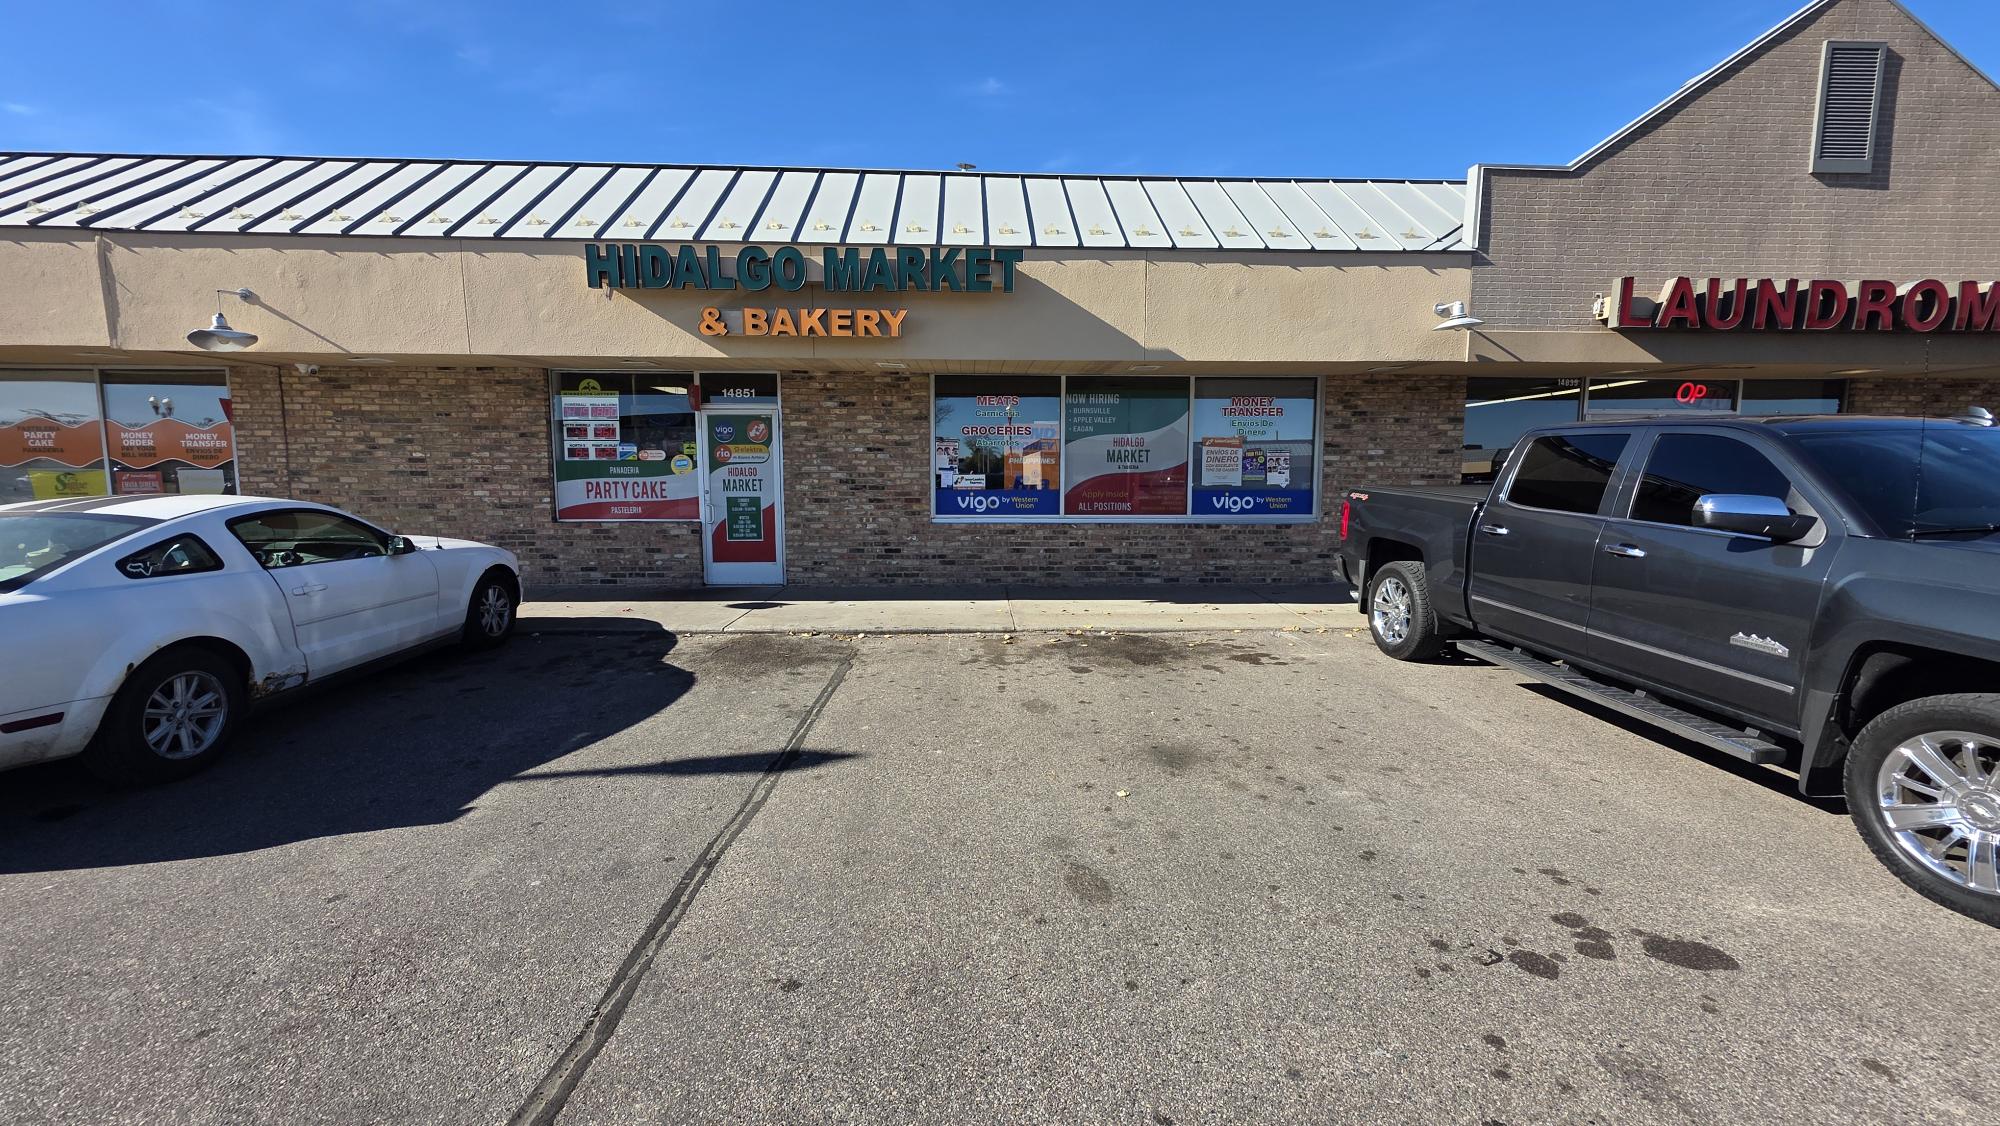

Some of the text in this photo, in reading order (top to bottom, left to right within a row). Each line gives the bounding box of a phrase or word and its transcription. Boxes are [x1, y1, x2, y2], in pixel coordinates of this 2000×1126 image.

[584, 243, 1026, 294] HIDALGO MARKET
[699, 306, 908, 337] & BAKERY
[722, 388, 755, 398] 14851
[976, 396, 1019, 406] MEATS
[1066, 394, 1120, 404] NOW HIRING
[1231, 396, 1275, 407] MONEY
[1221, 407, 1284, 416] TRANSFER
[715, 425, 733, 434] vigo
[961, 426, 1032, 436] GROCERIES
[24, 432, 56, 440] PARTY
[976, 438, 1020, 446] Abarrotes
[1113, 437, 1145, 448] HIDALGO
[716, 448, 730, 458] ria
[1106, 450, 1151, 464] MARKET
[610, 466, 640, 475] PANADERIA
[728, 467, 757, 477] HIDALGO
[586, 481, 668, 499] PARTY CAKE
[722, 479, 763, 492] MARKET
[1082, 489, 1128, 500] Apply inside
[958, 492, 1000, 512] vigo
[1078, 502, 1132, 511] ALL POSITIONS
[1212, 492, 1254, 512] vigo
[611, 506, 642, 514] PASTELERIA
